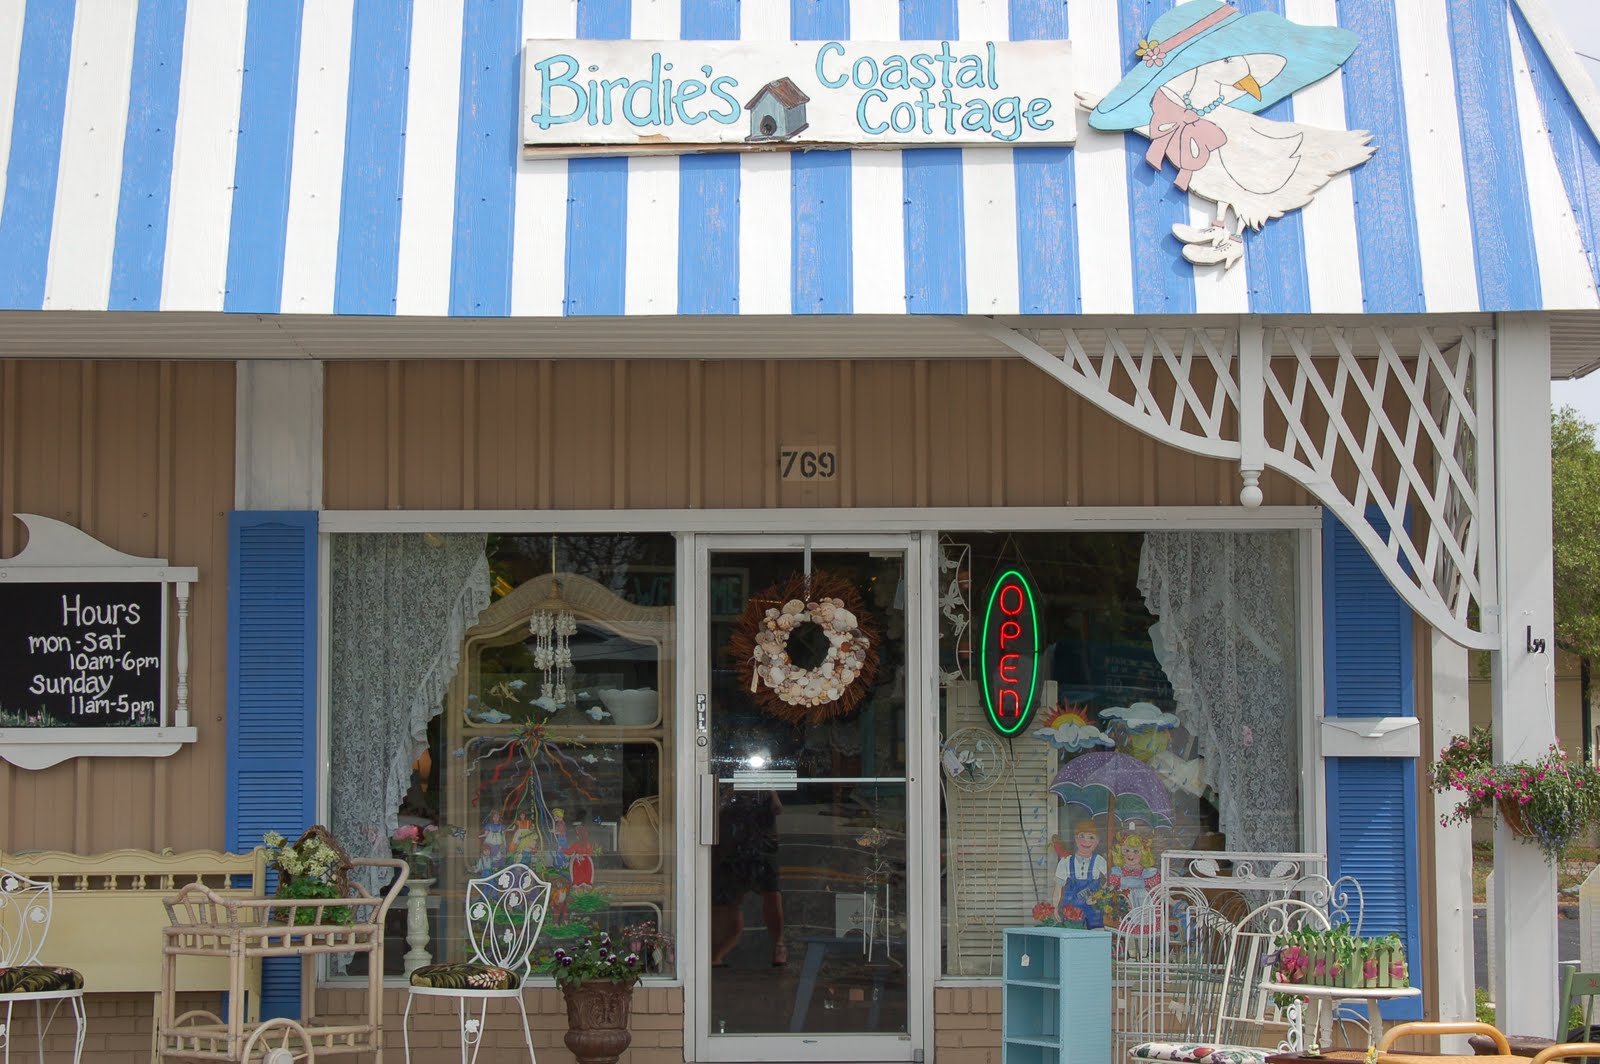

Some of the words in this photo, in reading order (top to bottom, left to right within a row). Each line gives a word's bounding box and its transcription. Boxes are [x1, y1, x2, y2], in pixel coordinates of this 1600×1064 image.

[815, 40, 999, 90] Coastal
[531, 53, 741, 130] Birdie's
[856, 88, 1055, 141] Cottage
[781, 450, 836, 478] 769
[62, 593, 141, 627] Hours
[70, 651, 159, 676] 10am-6pm
[29, 670, 114, 700] Sunday
[71, 694, 154, 720] 11am-5pm
[697, 694, 706, 730] PULL
